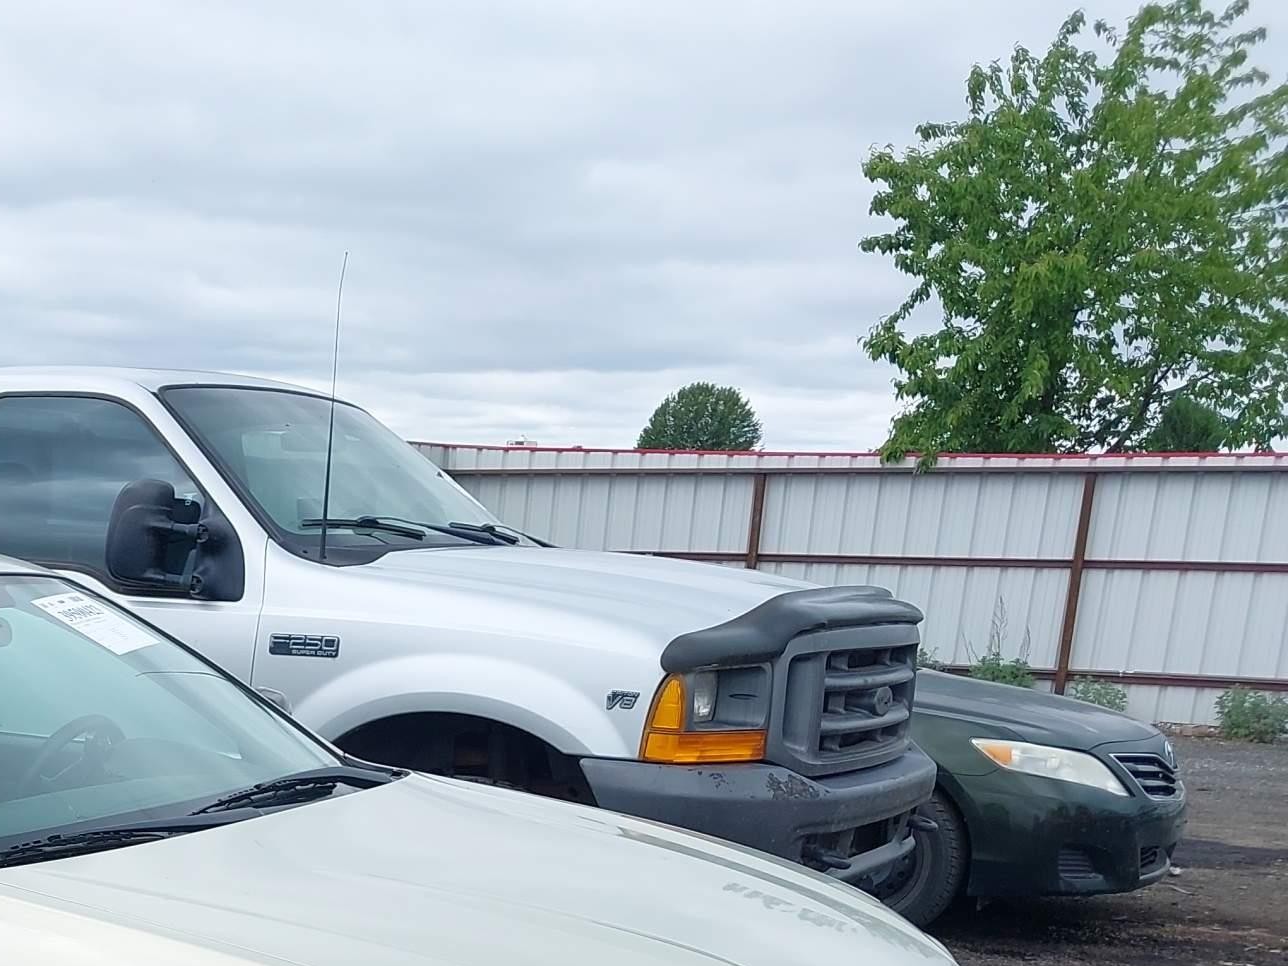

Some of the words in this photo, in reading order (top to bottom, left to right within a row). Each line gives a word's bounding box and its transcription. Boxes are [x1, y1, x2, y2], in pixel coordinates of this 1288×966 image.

[291, 649, 316, 657] SUPER
[317, 650, 337, 658] DUTY
[606, 692, 639, 710] V8
